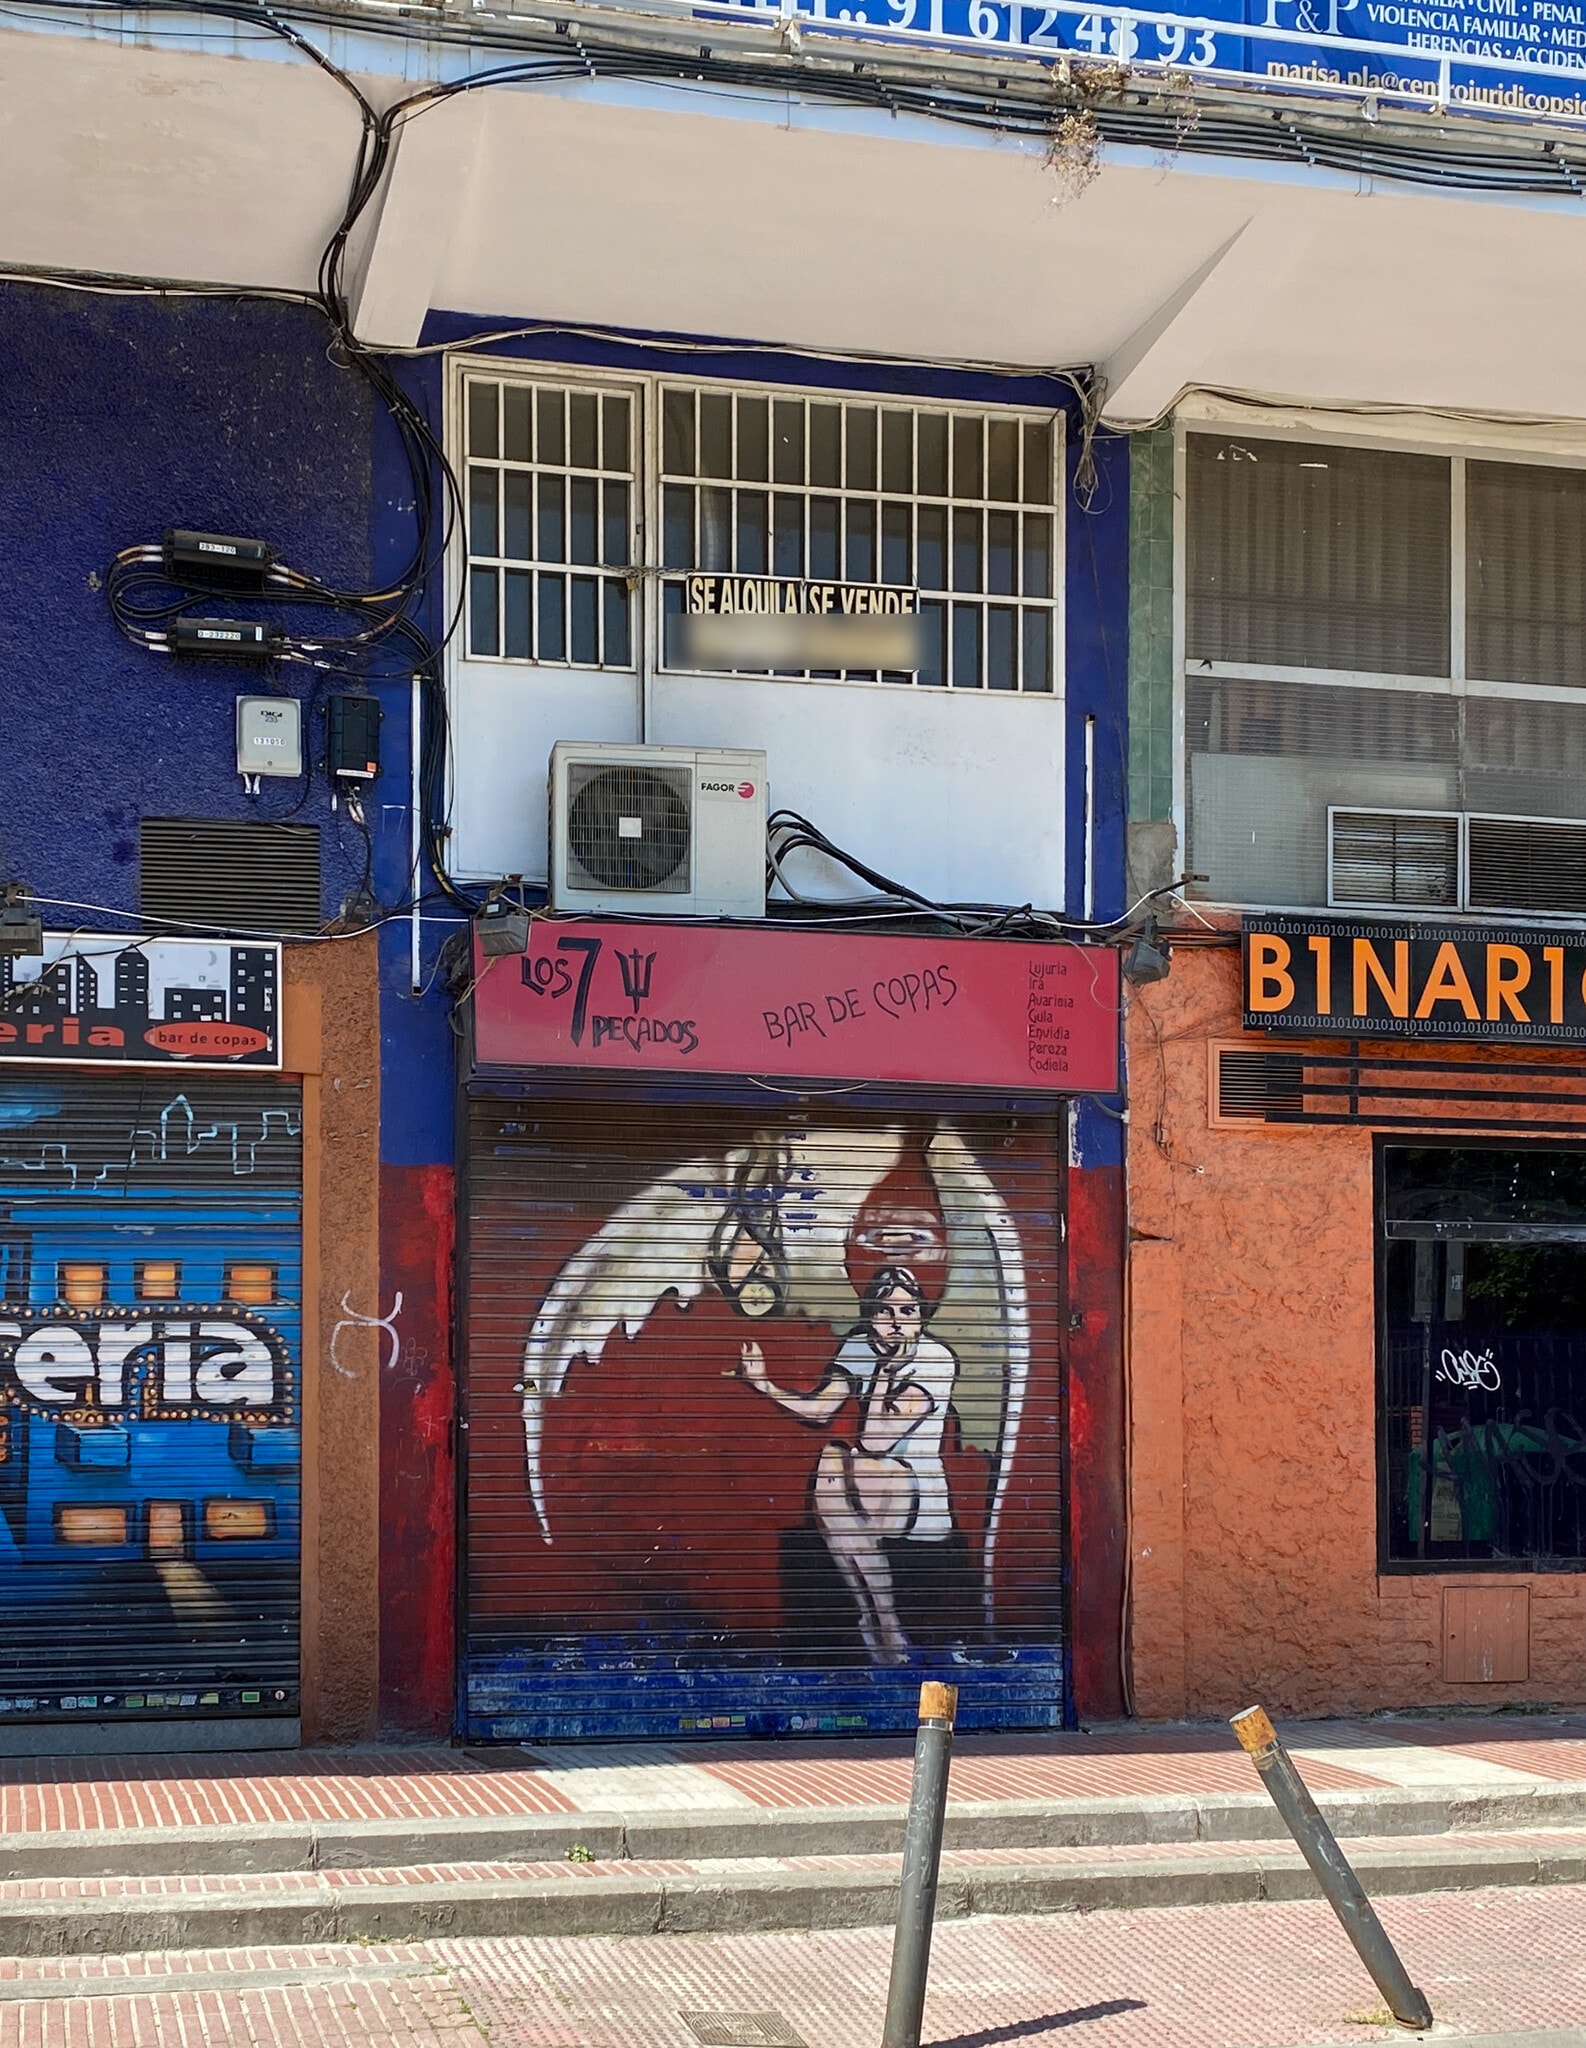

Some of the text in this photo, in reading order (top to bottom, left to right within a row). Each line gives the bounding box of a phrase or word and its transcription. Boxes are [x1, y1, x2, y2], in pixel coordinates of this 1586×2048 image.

[1367, 3, 1586, 49] VIOLENCIA FAMILIAR MED
[1533, 2, 1585, 26] PENAL
[967, 0, 1058, 48] 612
[1074, 13, 1139, 59] 48
[1156, 23, 1217, 67] 93
[1407, 32, 1586, 69] HERENCIAS ACCIDEN
[691, 577, 798, 614] SE ALQUILA
[840, 588, 914, 614] VENDE
[701, 782, 735, 792] FAGOR
[1029, 960, 1067, 979] Lujuria
[1029, 976, 1044, 990] Ira
[1249, 933, 1586, 1024] B1NAR1
[520, 936, 603, 1048] LOS 7
[762, 964, 957, 1048] BAR DE COPAS
[1028, 1008, 1053, 1024] Gula
[158, 1025, 186, 1045] bar
[190, 1026, 208, 1045] de
[214, 1033, 258, 1048] copas
[592, 1015, 699, 1055] PECADOS
[1029, 1040, 1067, 1057] Pereza
